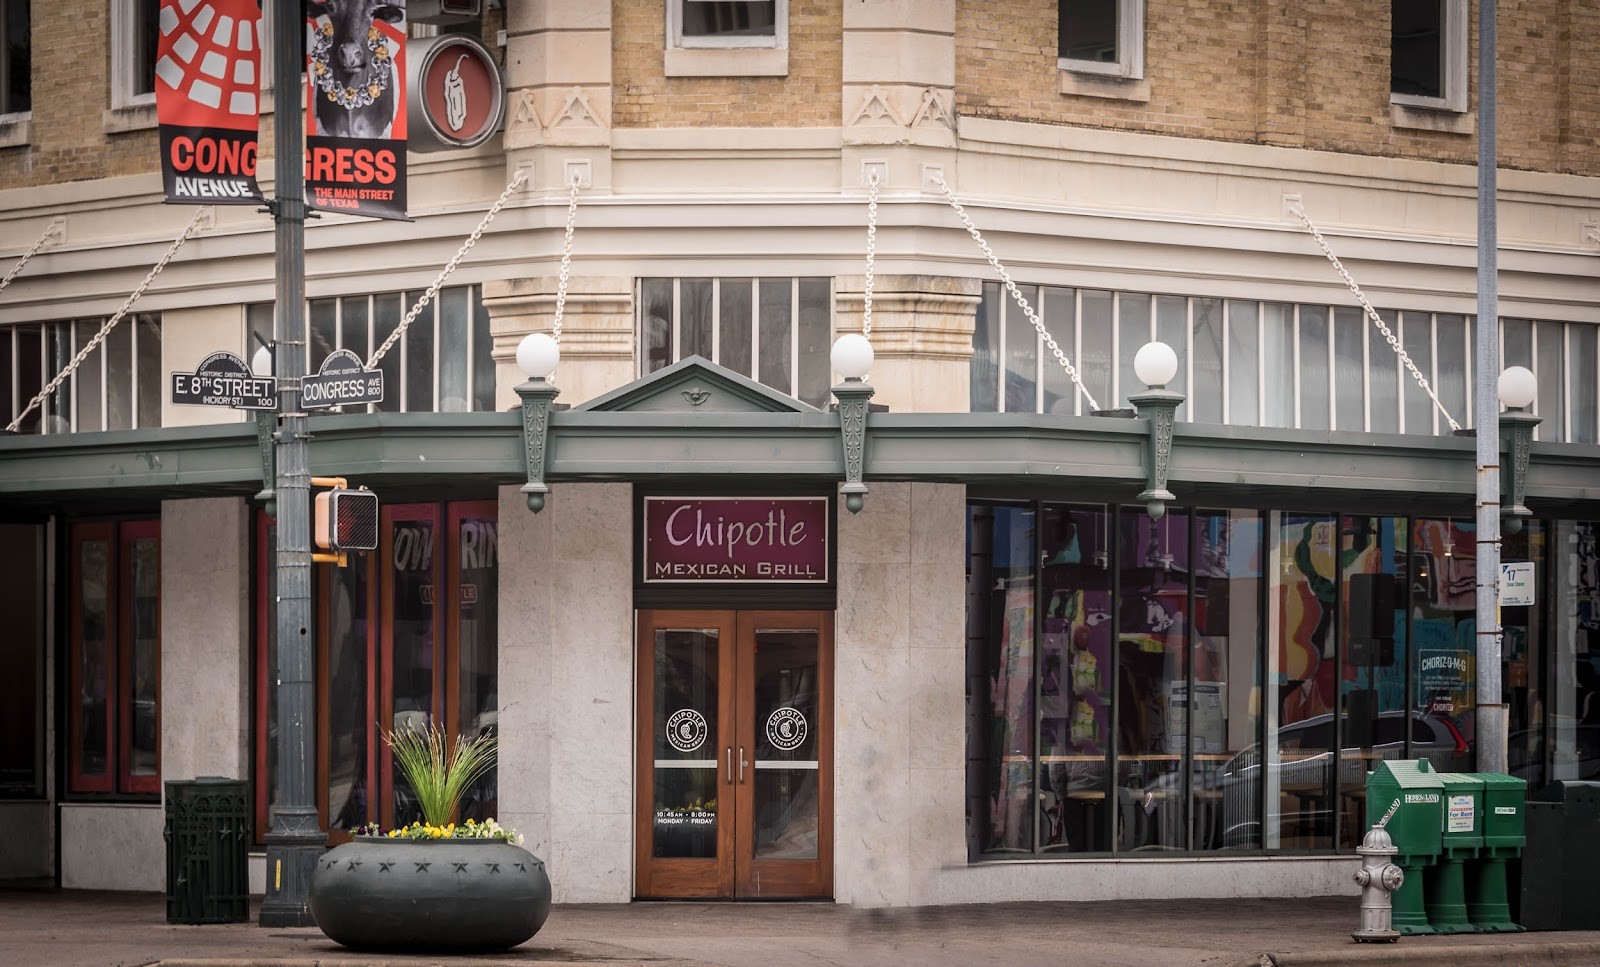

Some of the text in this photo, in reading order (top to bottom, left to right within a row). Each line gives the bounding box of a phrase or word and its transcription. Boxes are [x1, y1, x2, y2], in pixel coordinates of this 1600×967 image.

[170, 136, 257, 176] CONG
[175, 176, 254, 197] AVENUE
[314, 188, 394, 200] THE MAIN STREET
[316, 198, 360, 208] OF TEXAS
[200, 354, 248, 372] CONGRESS AVENUE
[176, 376, 271, 397] E. 8TH STREET
[368, 378, 380, 386] AVE
[304, 380, 365, 401] CONGRESS
[368, 387, 380, 396] 800
[258, 398, 273, 406] 100
[666, 504, 807, 558] Chipotle
[656, 562, 816, 574] MEXICAN GRILL
[1507, 570, 1516, 581] 17
[670, 712, 704, 728] CHIPOTLE
[770, 710, 804, 726] CHIPOTLE
[670, 734, 703, 748] MEXICAN GRILL
[771, 732, 803, 746] MEXICAN GRILL
